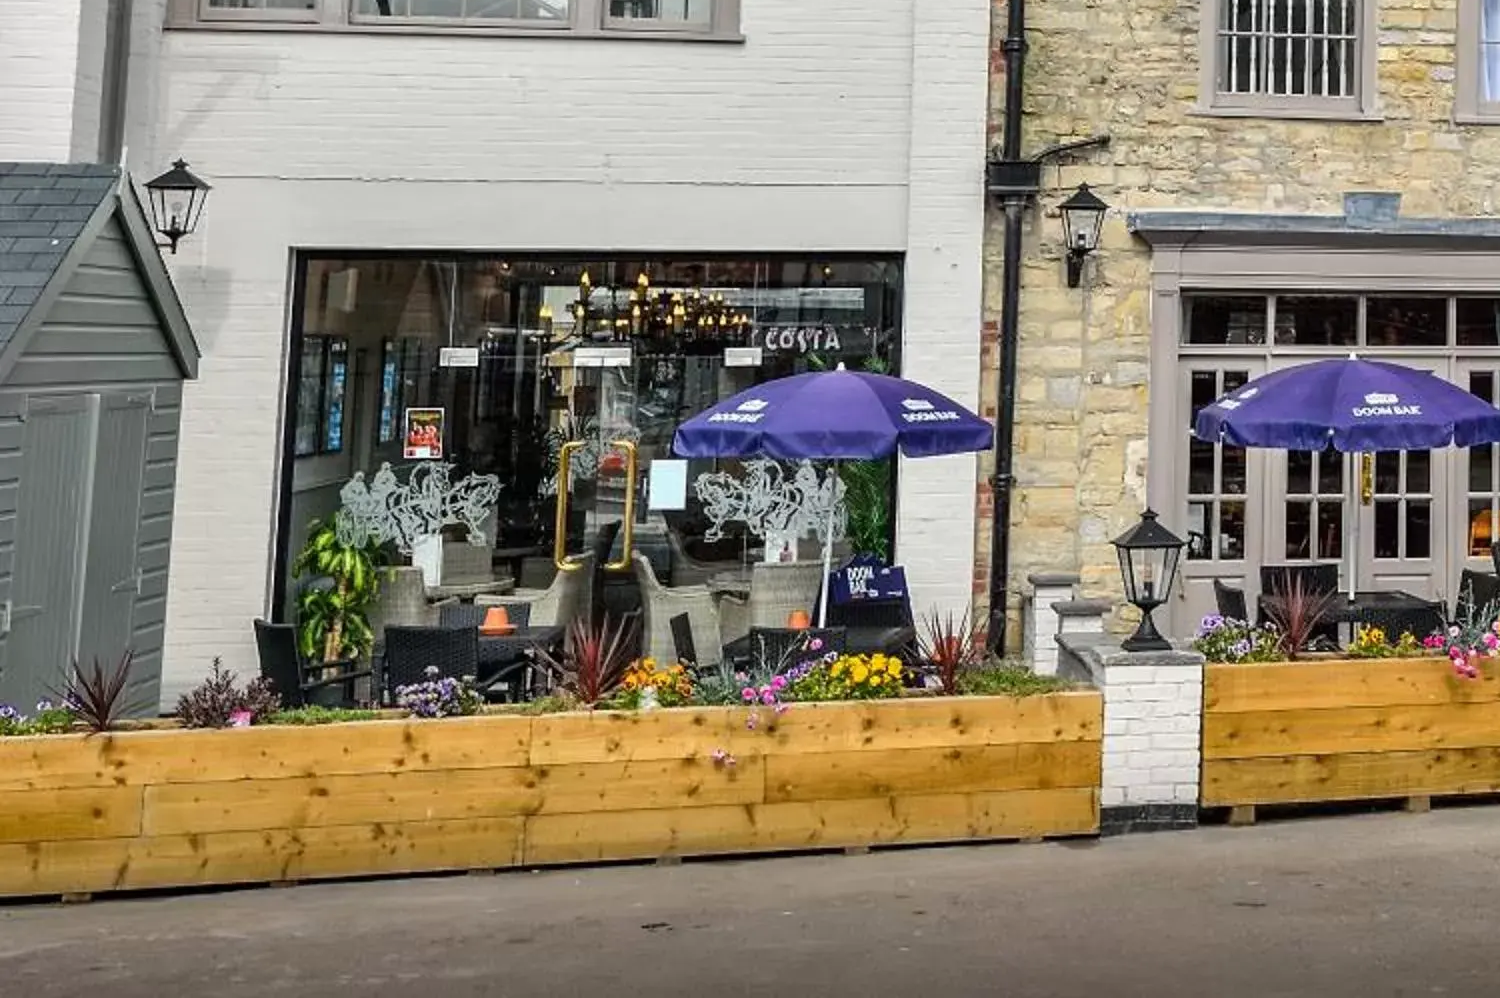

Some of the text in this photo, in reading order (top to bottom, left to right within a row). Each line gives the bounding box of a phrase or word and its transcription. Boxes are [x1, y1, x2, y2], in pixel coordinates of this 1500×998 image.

[765, 327, 841, 352] COSTA
[1352, 405, 1423, 417] DOOM BAR
